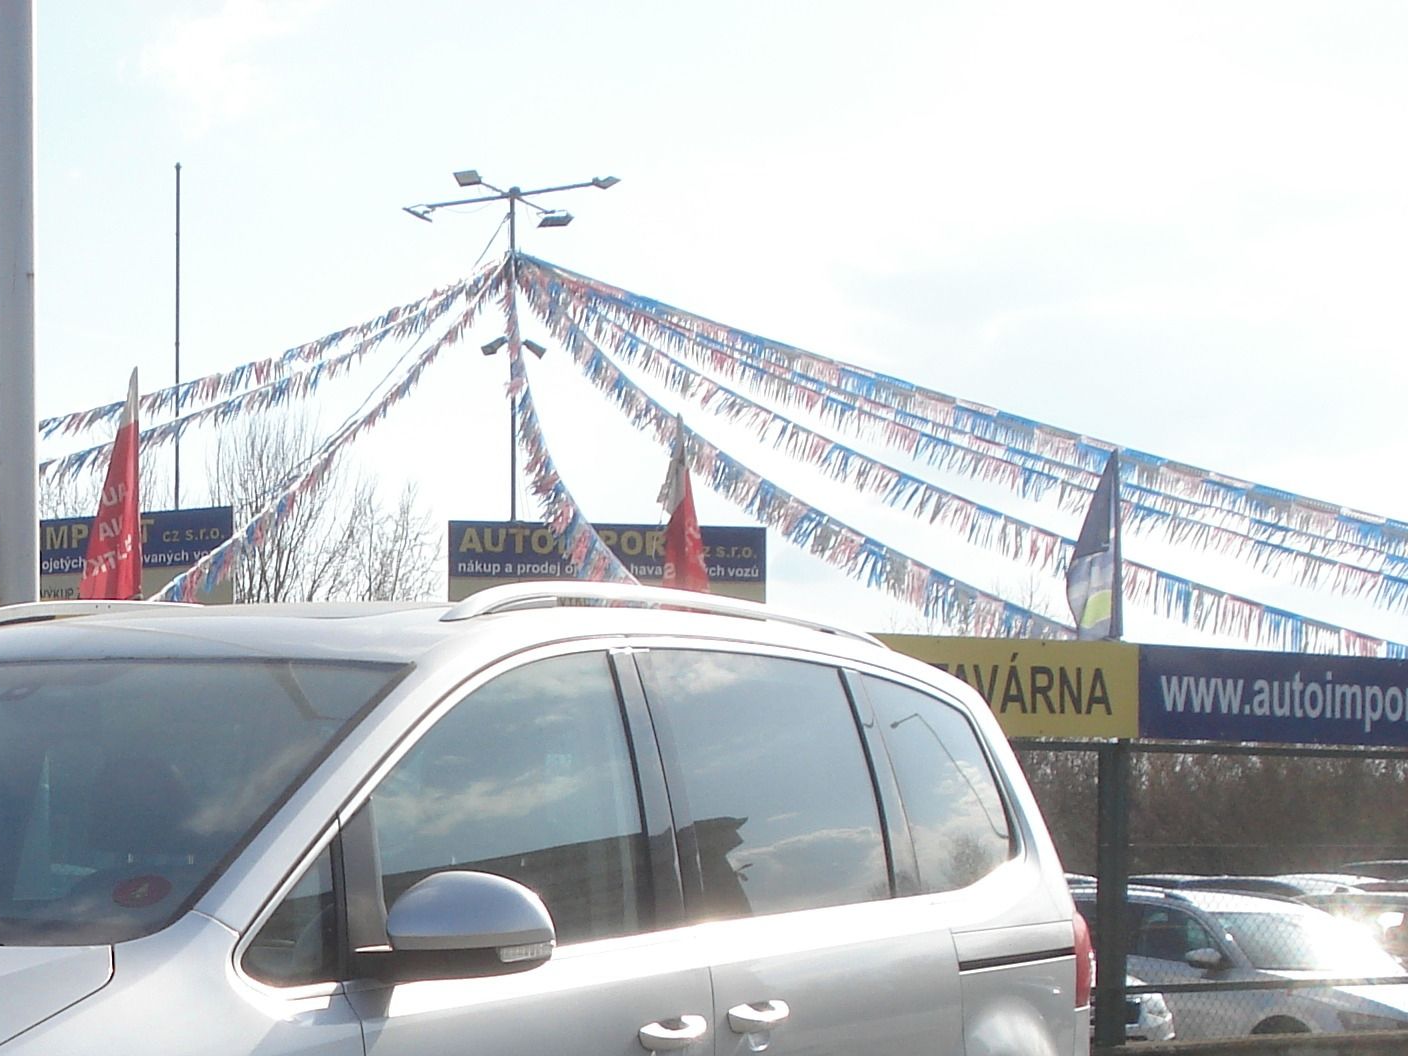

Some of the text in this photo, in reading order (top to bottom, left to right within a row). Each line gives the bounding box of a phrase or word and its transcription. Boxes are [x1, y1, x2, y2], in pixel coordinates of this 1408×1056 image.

[458, 559, 500, 575] nákup
[504, 564, 513, 573] a
[517, 561, 561, 577] prodej
